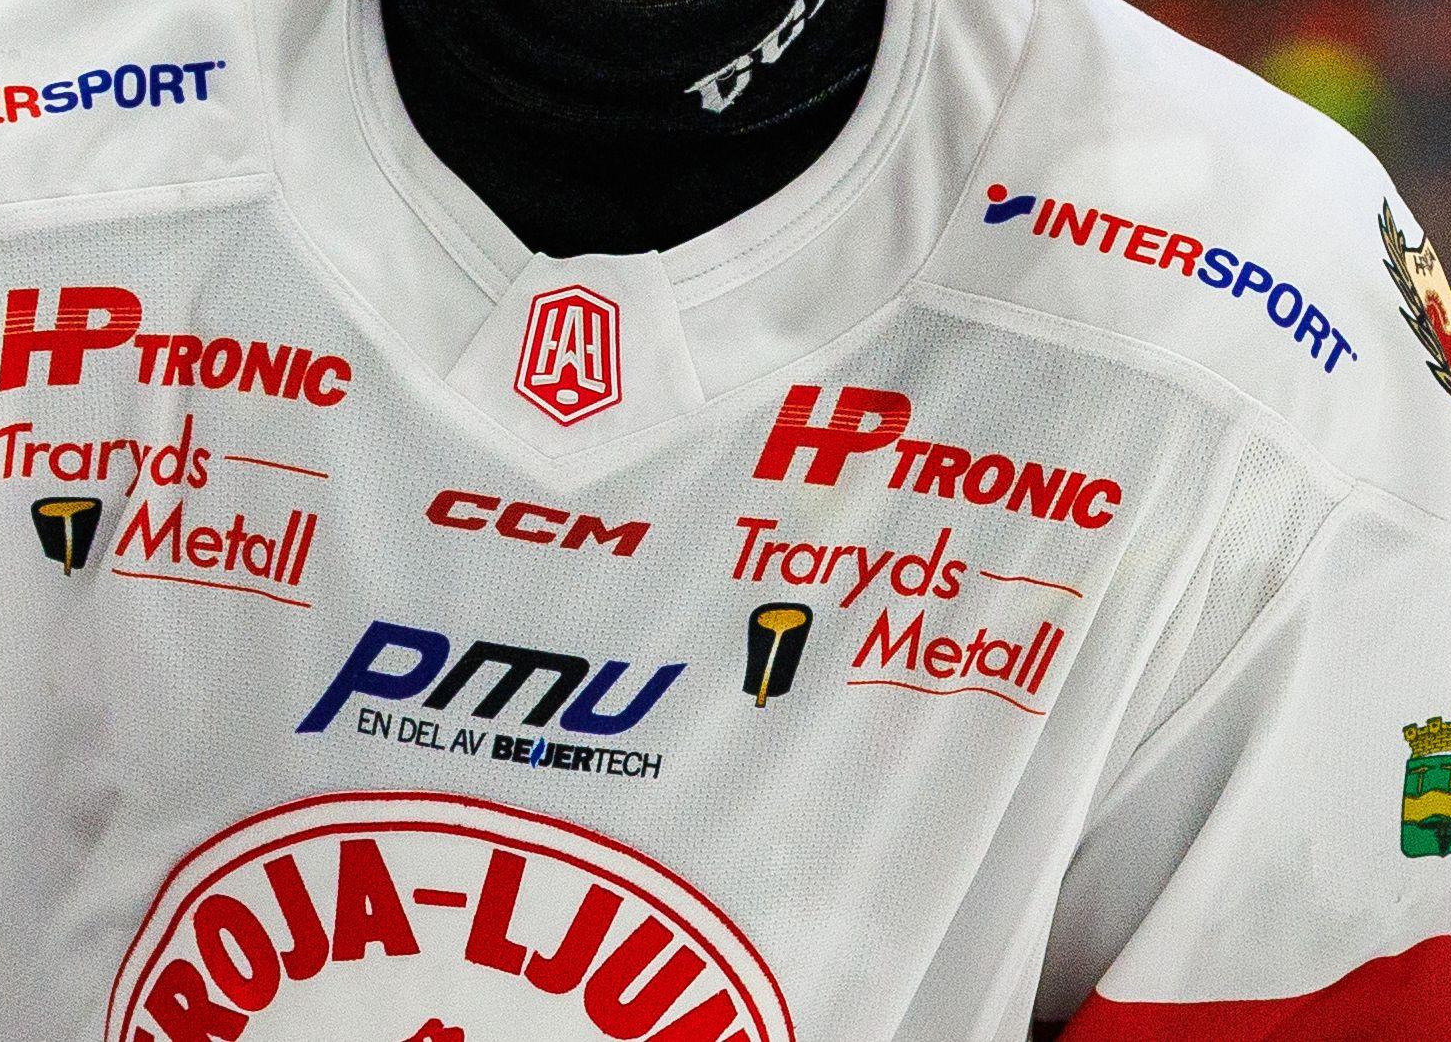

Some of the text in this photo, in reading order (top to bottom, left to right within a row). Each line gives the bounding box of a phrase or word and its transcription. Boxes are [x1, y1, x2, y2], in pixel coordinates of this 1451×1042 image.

[1032, 198, 1354, 374] INTERSPORT
[115, 499, 319, 587] Metall
[425, 489, 651, 557] CCM
[731, 516, 969, 608] Traryds
[852, 608, 1065, 695] Metall
[357, 708, 392, 739] EN
[398, 717, 445, 751] DEL
[450, 729, 488, 756] AV
[134, 839, 754, 1042] ROJA-LJU
